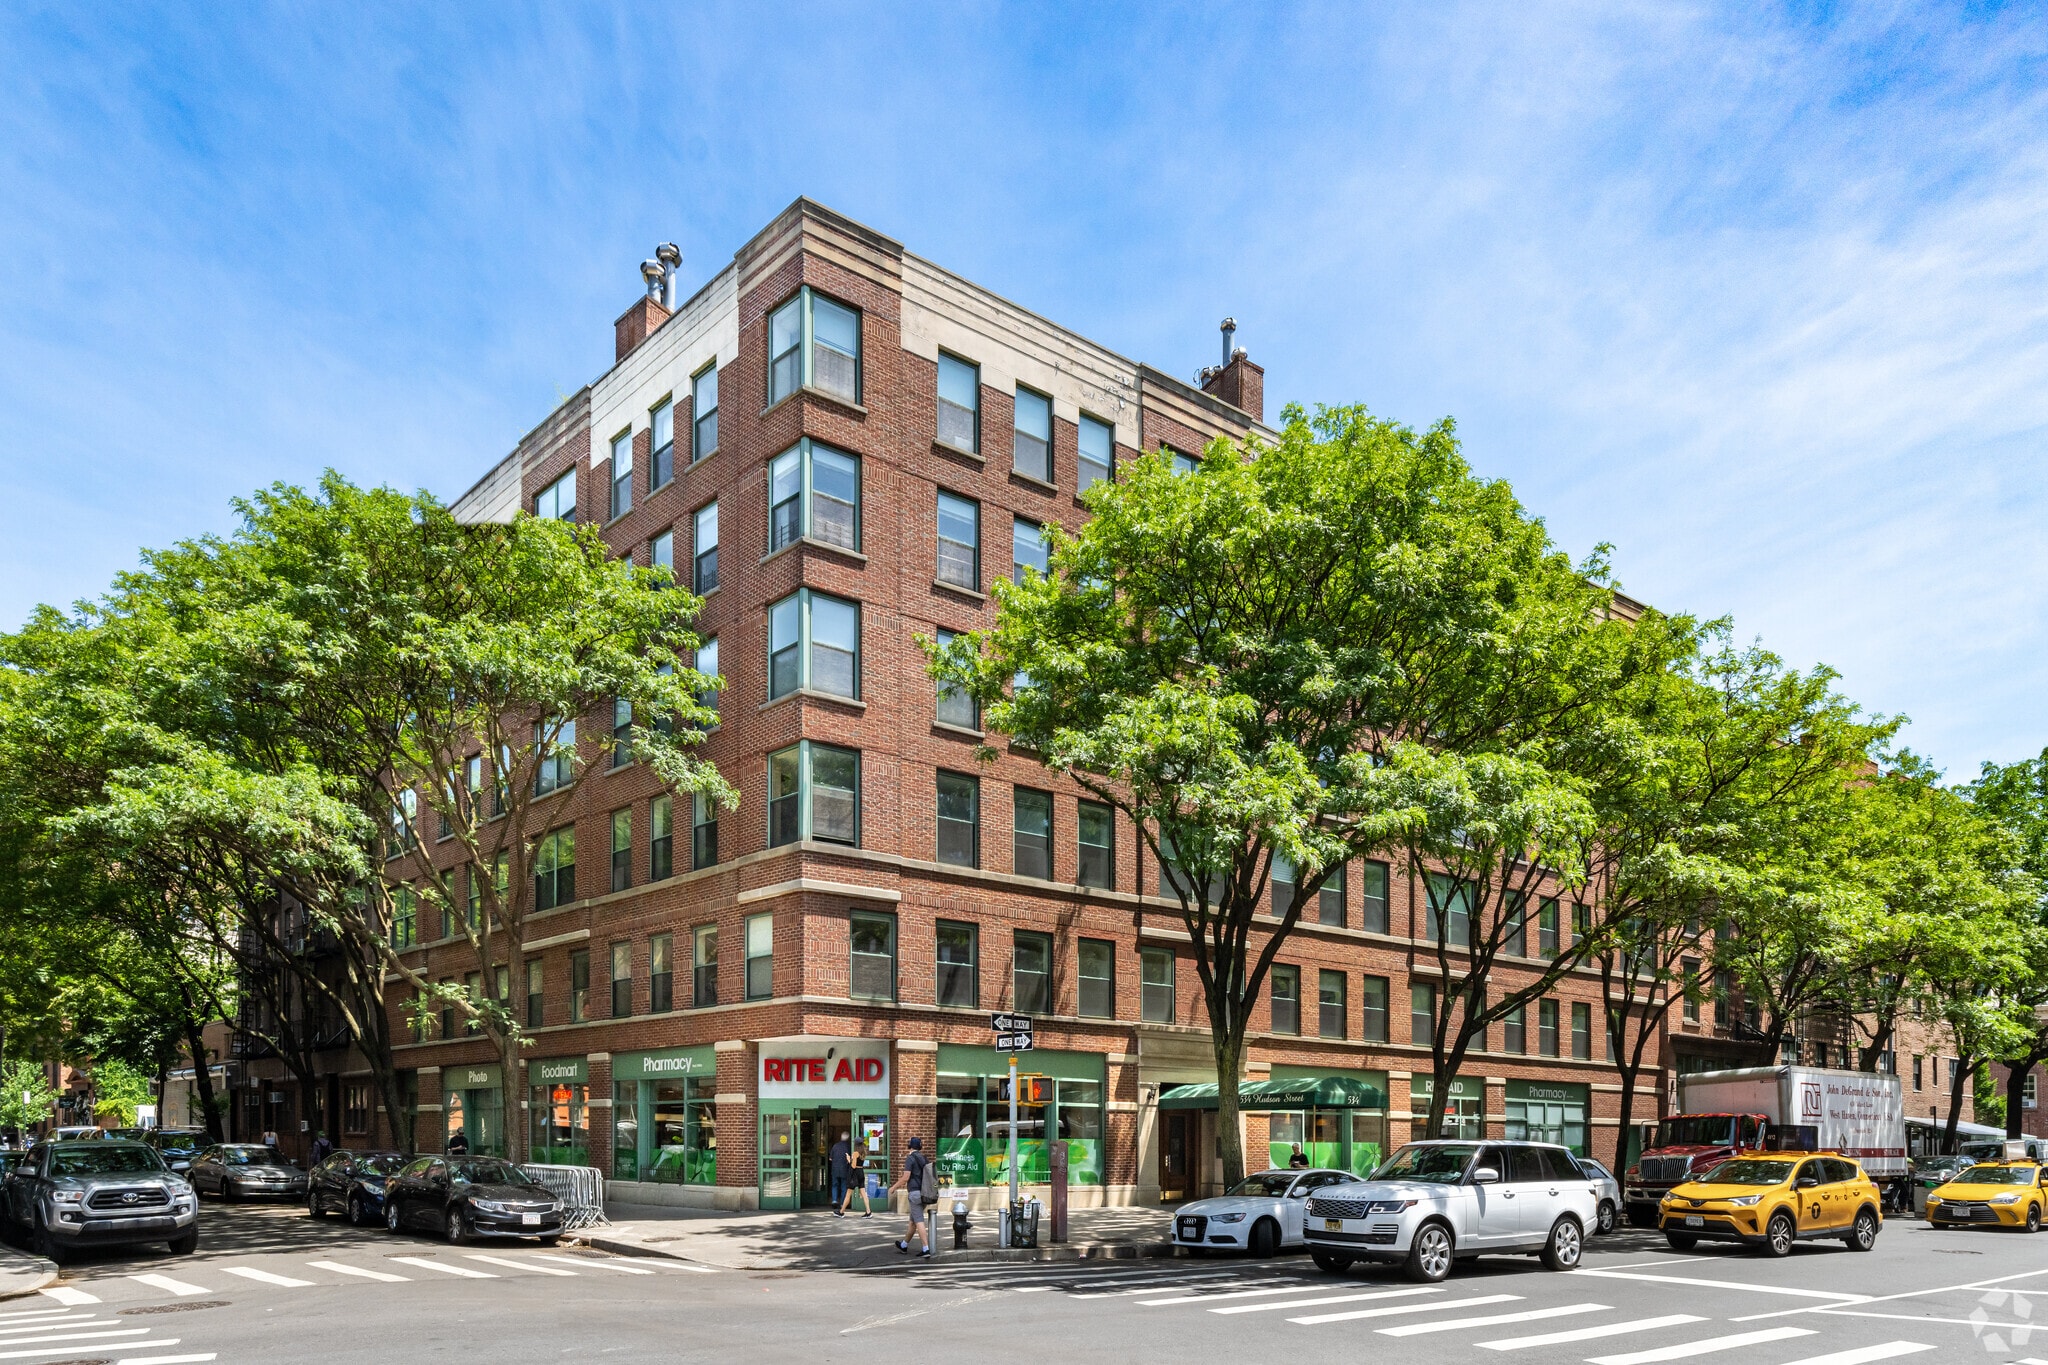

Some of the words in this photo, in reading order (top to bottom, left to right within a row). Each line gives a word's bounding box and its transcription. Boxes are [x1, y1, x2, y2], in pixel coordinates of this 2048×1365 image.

[998, 1019, 1011, 1027] ONE
[1015, 1020, 1028, 1028] WAY
[1001, 1038, 1012, 1047] ONE
[1015, 1037, 1027, 1045] WAY
[643, 1057, 692, 1073] Pharmacy
[764, 1058, 826, 1082] RITE
[833, 1058, 884, 1082] AID
[468, 1070, 488, 1083] Photo
[541, 1063, 578, 1079] Foodmart
[1448, 1081, 1464, 1094] AID
[1529, 1085, 1567, 1100] Pharmacy
[1826, 1084, 1839, 1094] John
[1240, 1095, 1251, 1104] 534
[1253, 1094, 1280, 1104] Hudson
[1283, 1093, 1304, 1103] Street
[1347, 1095, 1360, 1105] 534
[1829, 1110, 1840, 1119] West
[941, 1163, 950, 1172] by
[952, 1163, 965, 1171] Rite
[967, 1163, 978, 1171] Aid
